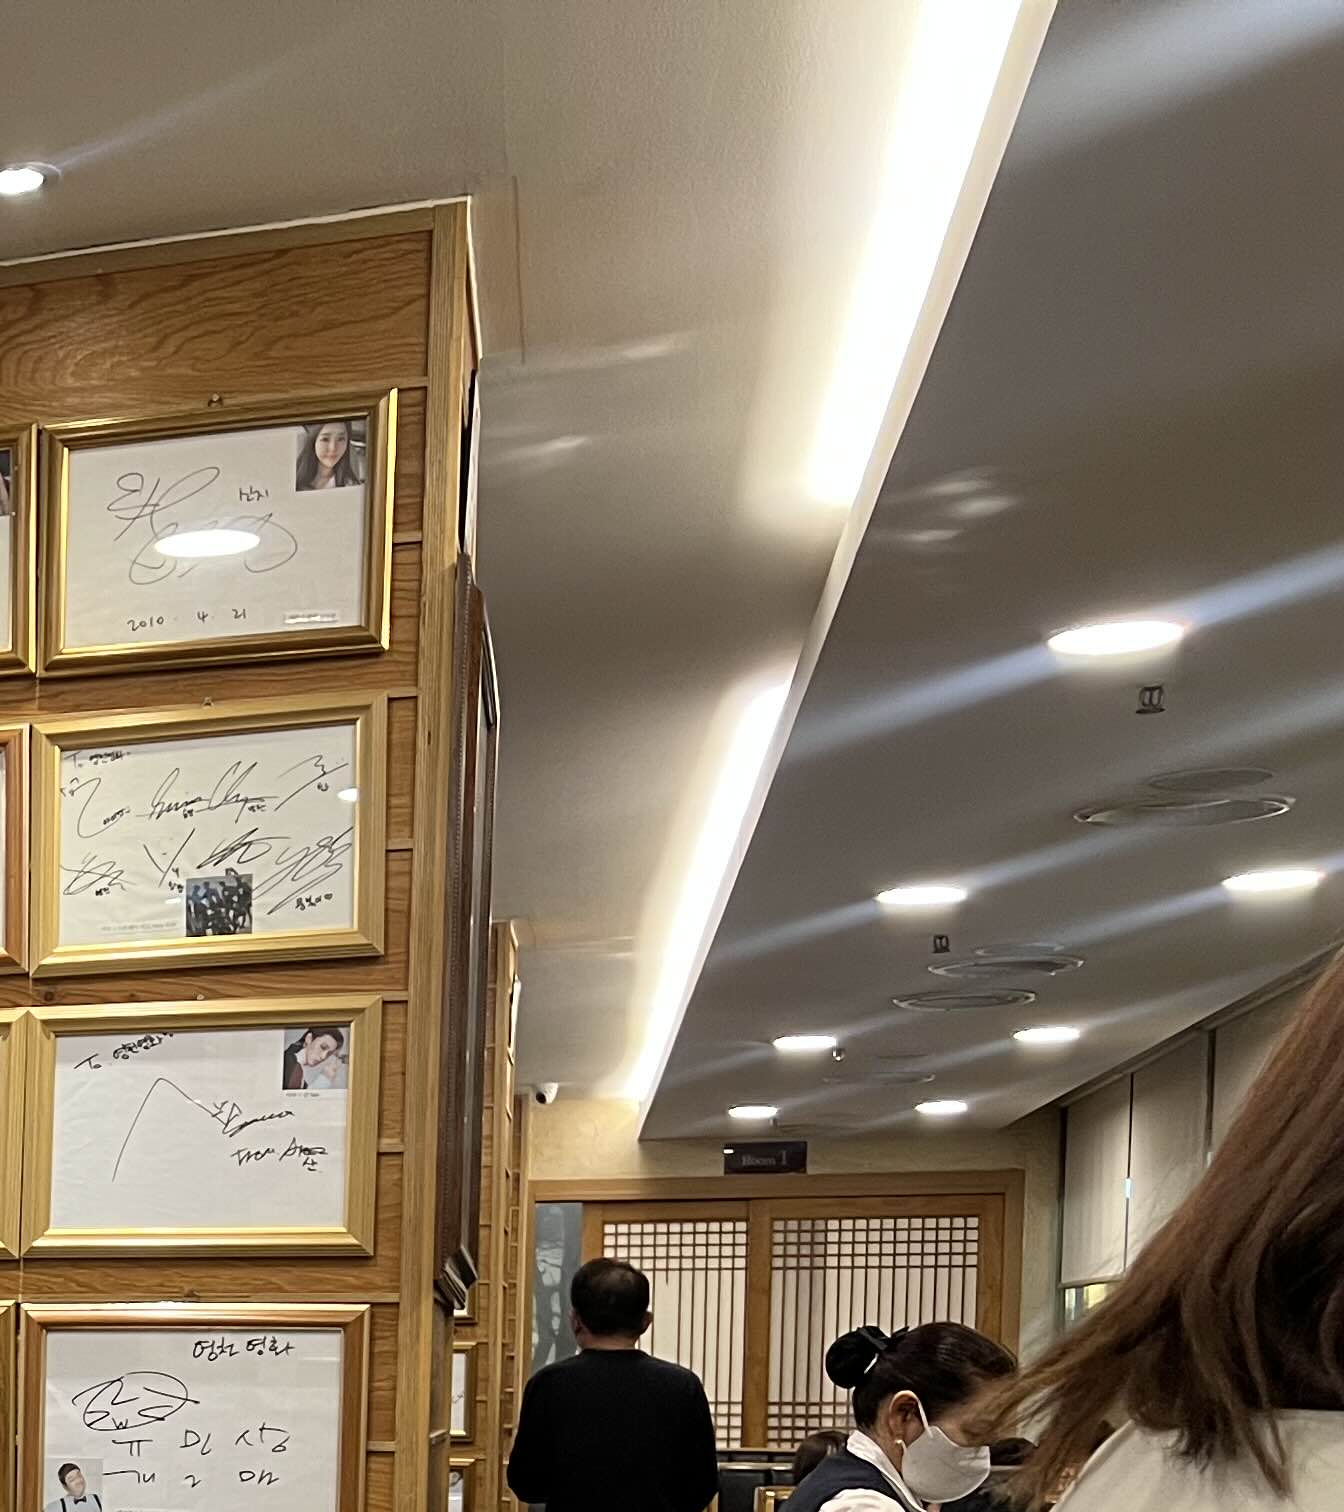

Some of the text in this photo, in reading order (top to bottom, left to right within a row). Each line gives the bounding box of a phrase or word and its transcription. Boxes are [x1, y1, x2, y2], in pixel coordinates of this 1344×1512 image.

[126, 608, 247, 632] 2010 4 21
